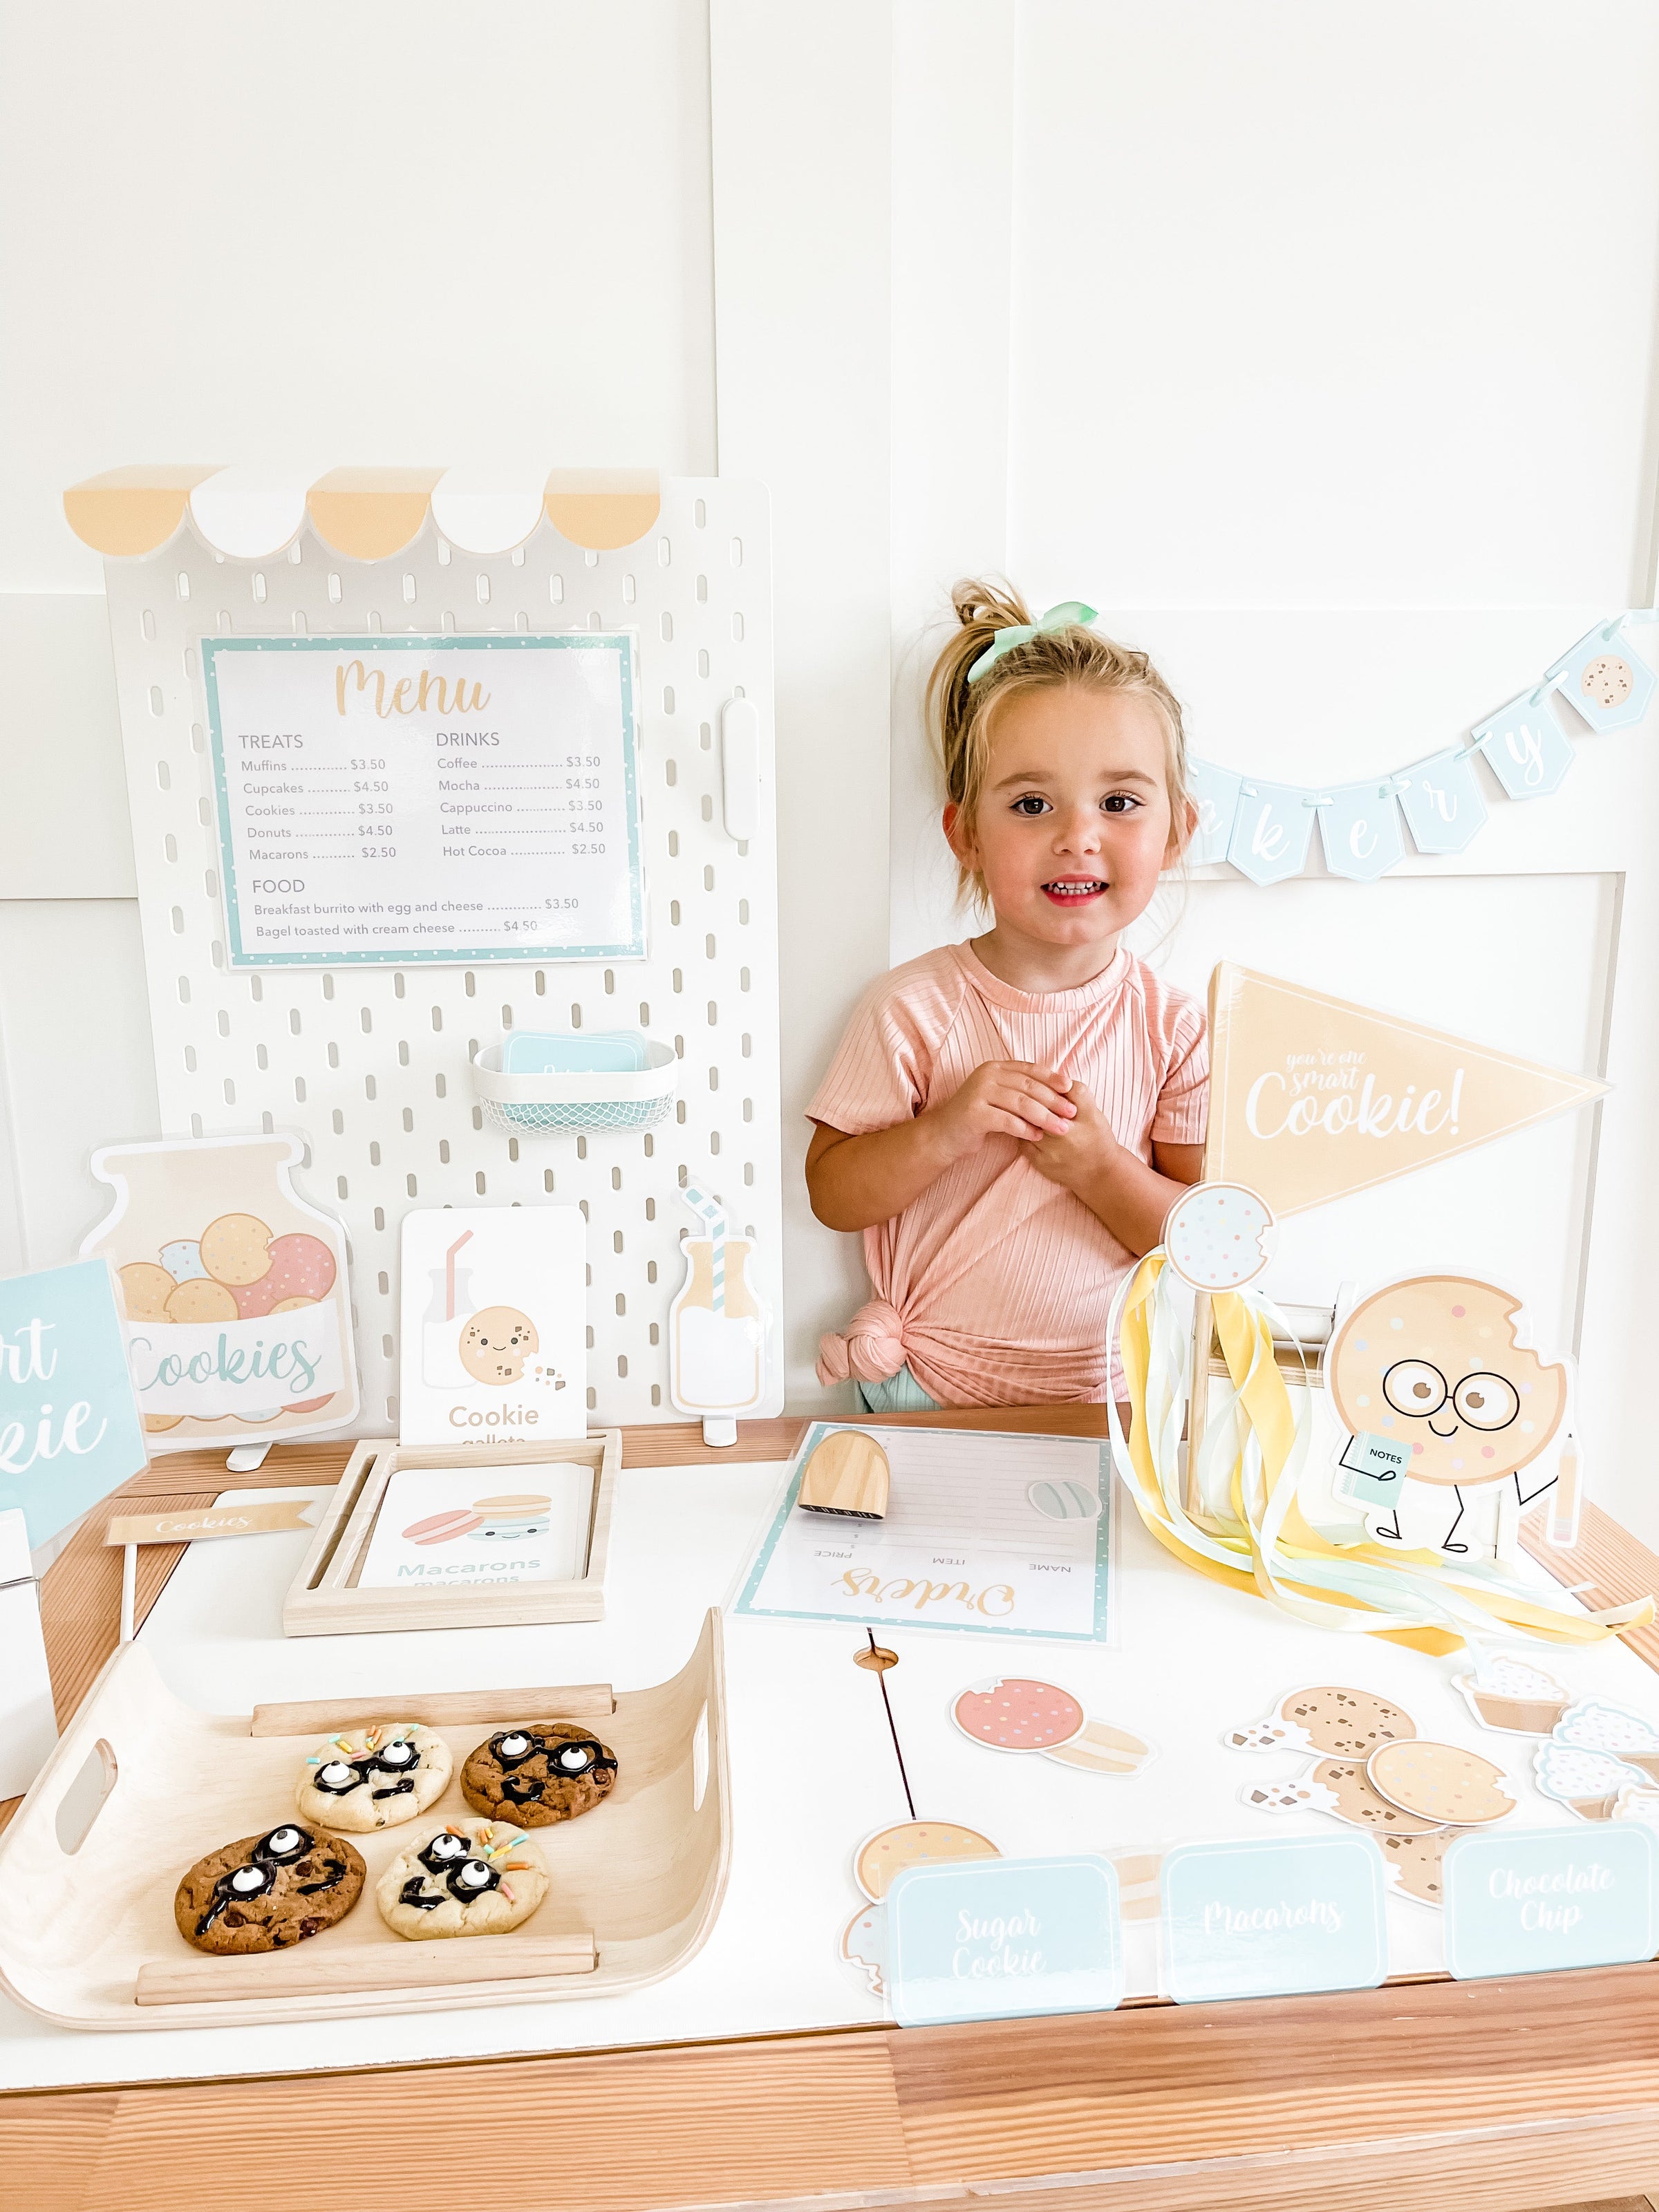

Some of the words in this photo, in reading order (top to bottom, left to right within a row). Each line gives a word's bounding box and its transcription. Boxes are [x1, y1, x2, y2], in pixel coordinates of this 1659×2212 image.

[336, 659, 491, 719] Menu
[238, 735, 303, 749] TREATS
[436, 732, 500, 747] DRINKS
[241, 760, 287, 771] Muffins
[350, 759, 385, 770] $3.50
[438, 758, 478, 769] Coffee
[566, 756, 600, 767] $3.50
[243, 782, 303, 796] Cupcakes
[353, 781, 388, 792] $4.50
[438, 780, 480, 791] Mocha
[565, 778, 599, 789] $4.50
[245, 805, 295, 816] Cookies
[358, 803, 393, 814] $3.50
[440, 802, 512, 816] Cappuccino
[568, 800, 603, 812] $3.50
[247, 827, 292, 838] Donuts
[358, 825, 393, 836] $4.50
[442, 825, 471, 834] Latte
[570, 822, 603, 833] $4.50
[249, 849, 308, 860] Macarons
[362, 847, 396, 858] $2.50
[443, 846, 465, 856] Hot
[469, 845, 507, 856] Cocoa
[572, 843, 606, 854] $2.50
[253, 879, 305, 893] FOOD
[254, 903, 310, 915] Breakfast
[314, 903, 355, 914] burrito
[358, 902, 384, 913] with
[388, 903, 411, 915] egg
[415, 901, 438, 912] and
[441, 900, 483, 911] cheese
[545, 898, 579, 909] $3.50
[256, 926, 290, 939] Bagel
[294, 924, 339, 936] toasted
[343, 924, 368, 935] with
[372, 925, 409, 934] cream
[413, 923, 455, 933] cheese
[503, 920, 538, 931] $4.50
[1286, 1048, 1335, 1073] you're
[1339, 1049, 1367, 1065] one
[1289, 1066, 1360, 1097] smart
[1245, 1067, 1465, 1140] Cookie!
[129, 1333, 322, 1394] Cookies
[449, 1403, 539, 1427] Cookie
[1369, 1448, 1403, 1464] NOTES
[156, 1515, 253, 1534] Cookies
[814, 1550, 852, 1559] PRICE
[932, 1556, 966, 1565] ITEM
[397, 1559, 541, 1577] Macarons
[1029, 1562, 1071, 1573] NAME
[831, 1567, 1015, 1617] Orders
[1489, 1863, 1615, 1900] Chocolate
[1204, 1898, 1345, 1936] Macarons
[1521, 1900, 1583, 1935] Chip
[955, 1908, 1042, 1951] Sugar
[952, 1944, 1047, 1980] Cookie
